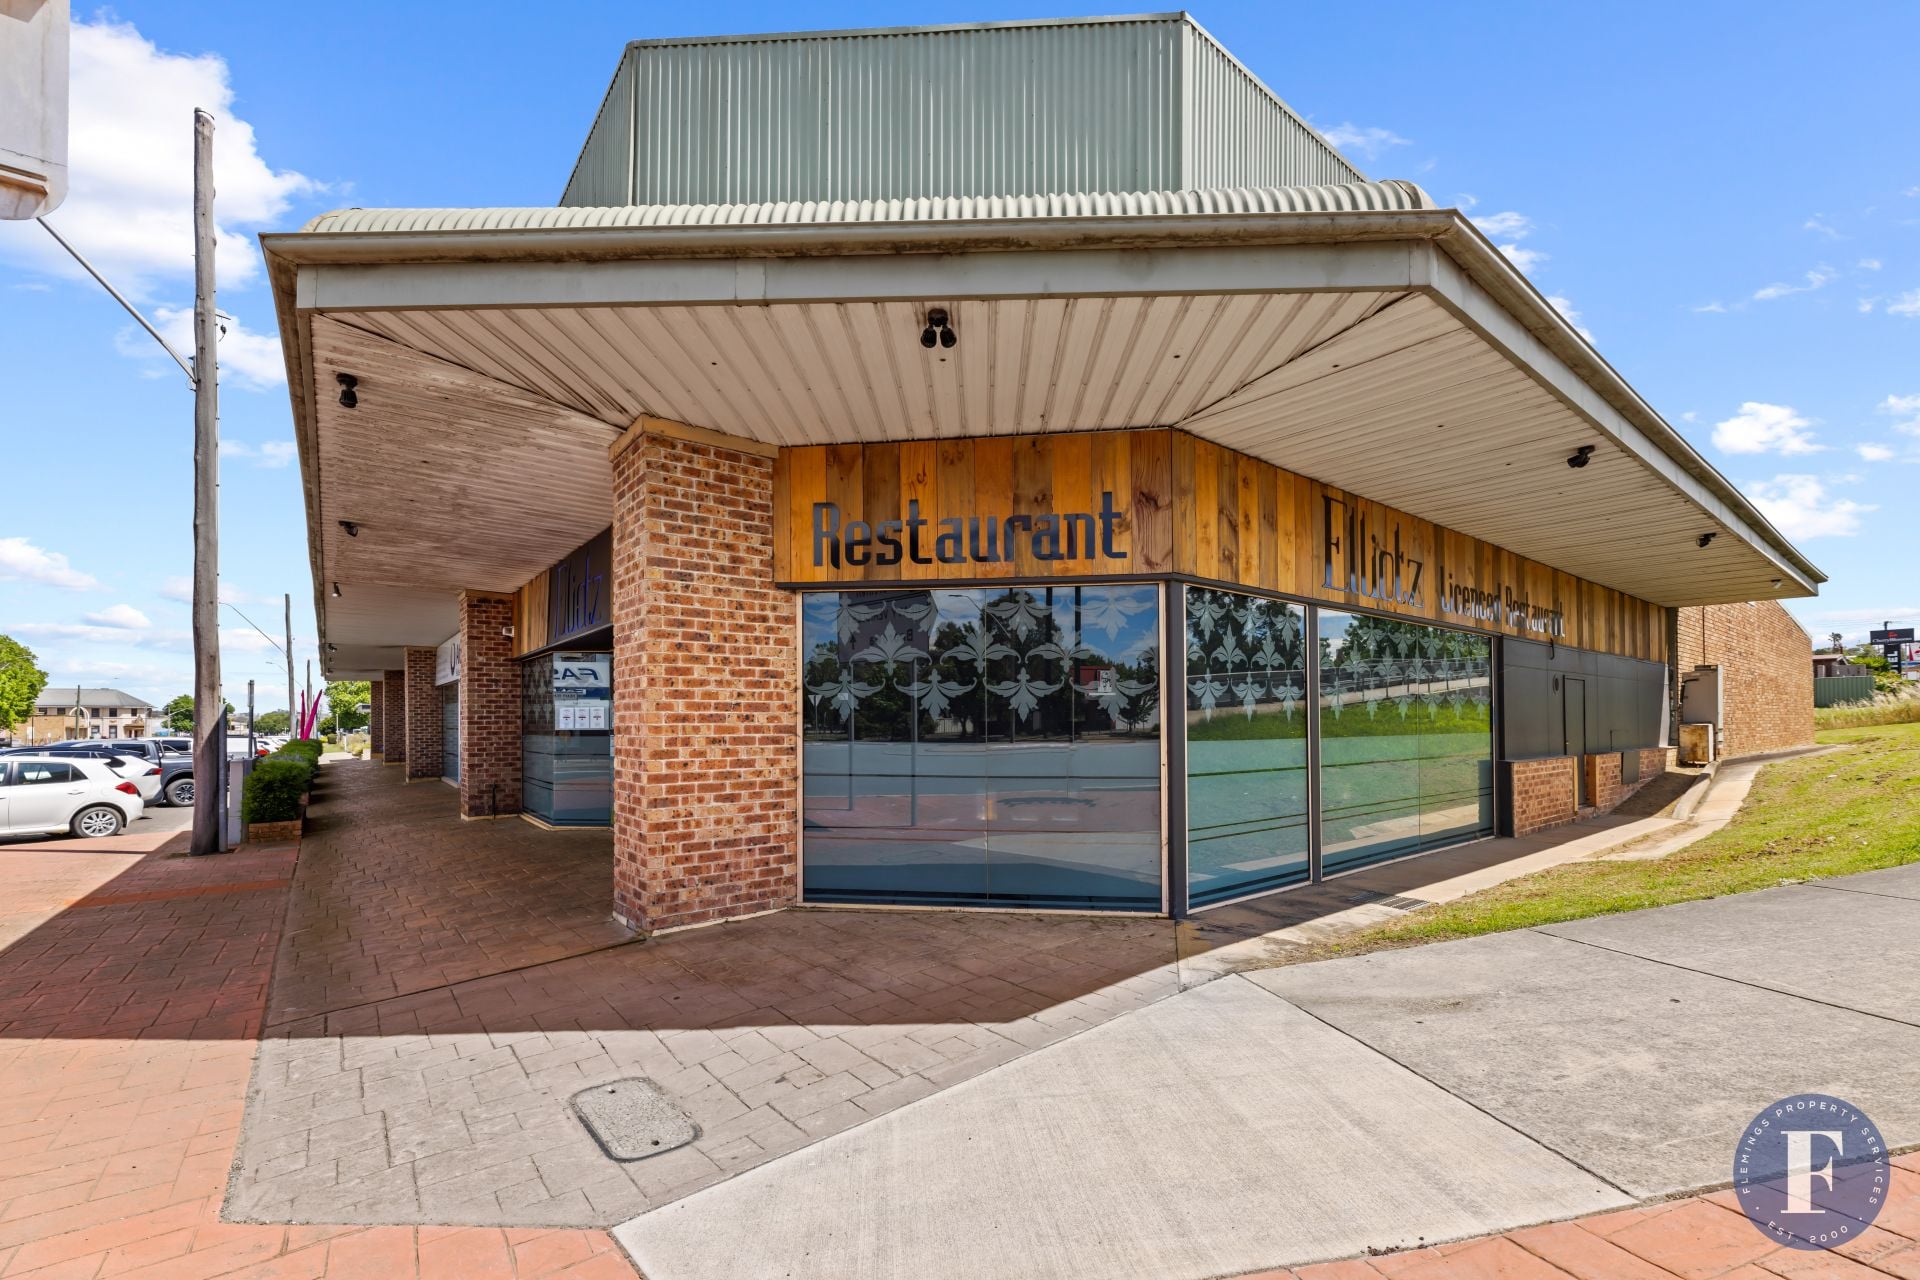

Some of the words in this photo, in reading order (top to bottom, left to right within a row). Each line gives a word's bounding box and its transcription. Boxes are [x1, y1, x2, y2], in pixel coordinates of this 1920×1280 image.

[813, 491, 1127, 570] Restaurant
[1321, 494, 1424, 608] Elliotz
[1440, 566, 1502, 624] Licenced
[1505, 585, 1565, 638] Restaurant
